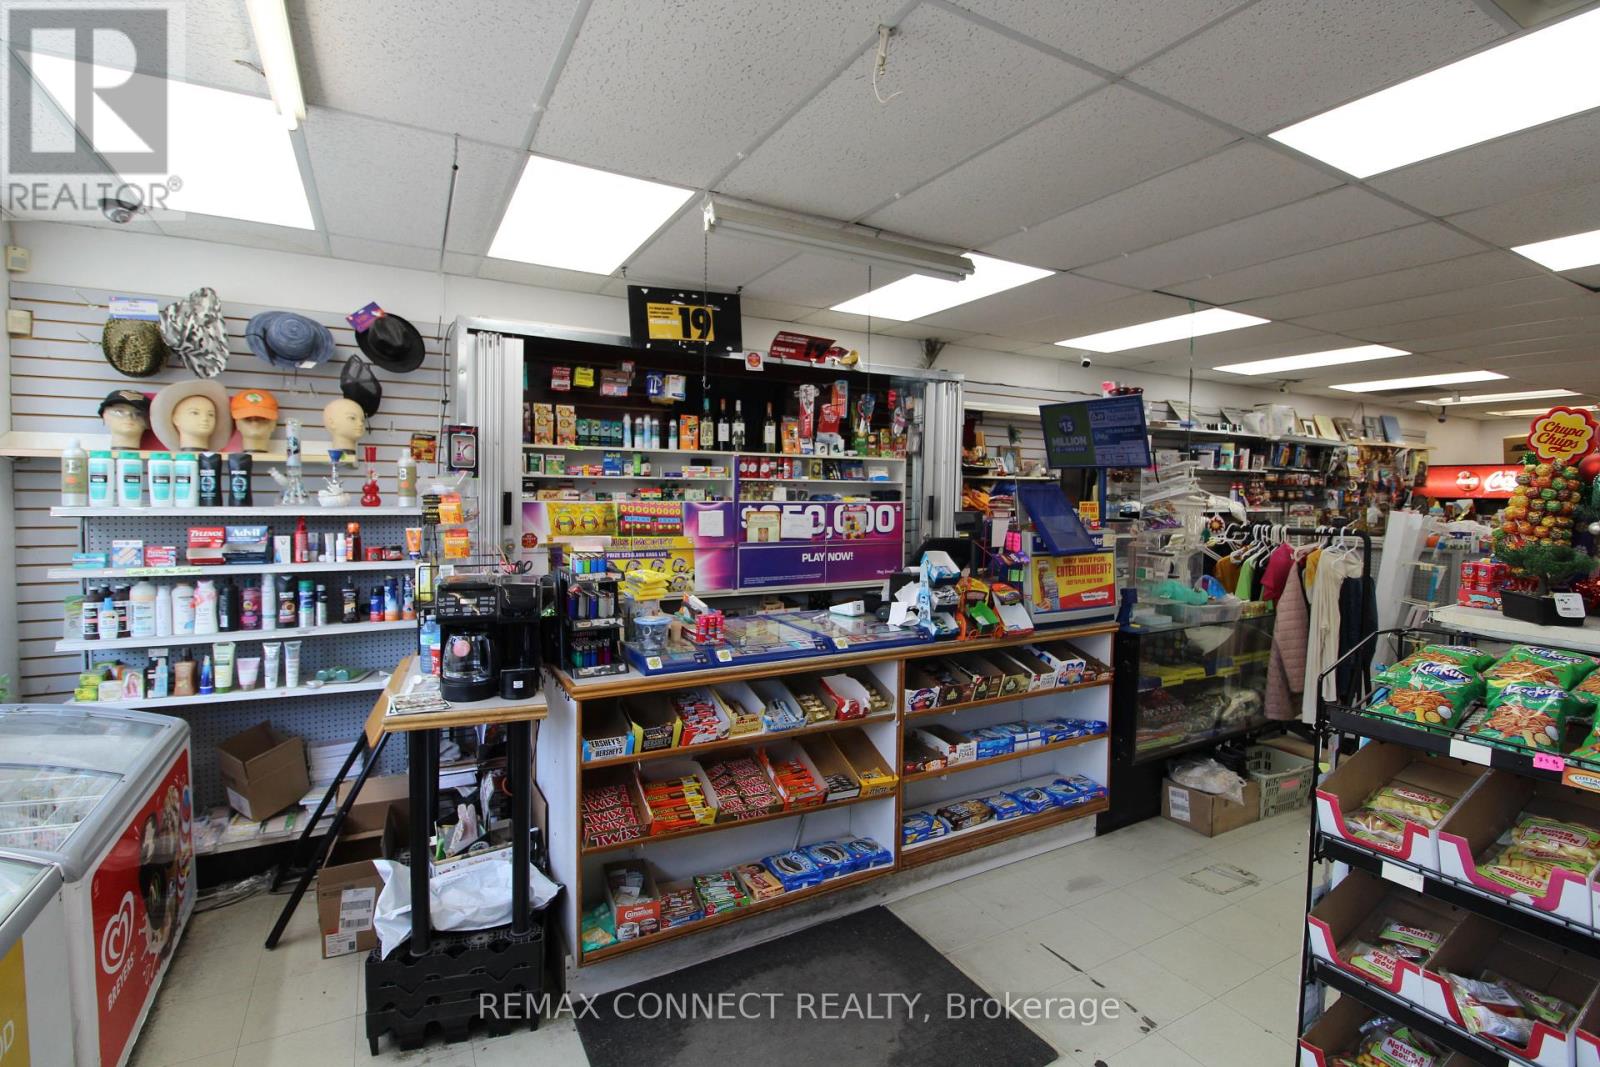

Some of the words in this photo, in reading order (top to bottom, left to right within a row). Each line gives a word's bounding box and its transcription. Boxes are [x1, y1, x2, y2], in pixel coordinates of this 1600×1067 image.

[678, 306, 712, 340] 19
[1543, 421, 1586, 438] Chupa
[1051, 435, 1087, 447] MILLION
[1536, 432, 1579, 449] Chups
[231, 528, 260, 537] Advil
[801, 552, 825, 563] PLAY
[827, 551, 854, 562] NOW!
[107, 952, 135, 1012] BREYERS
